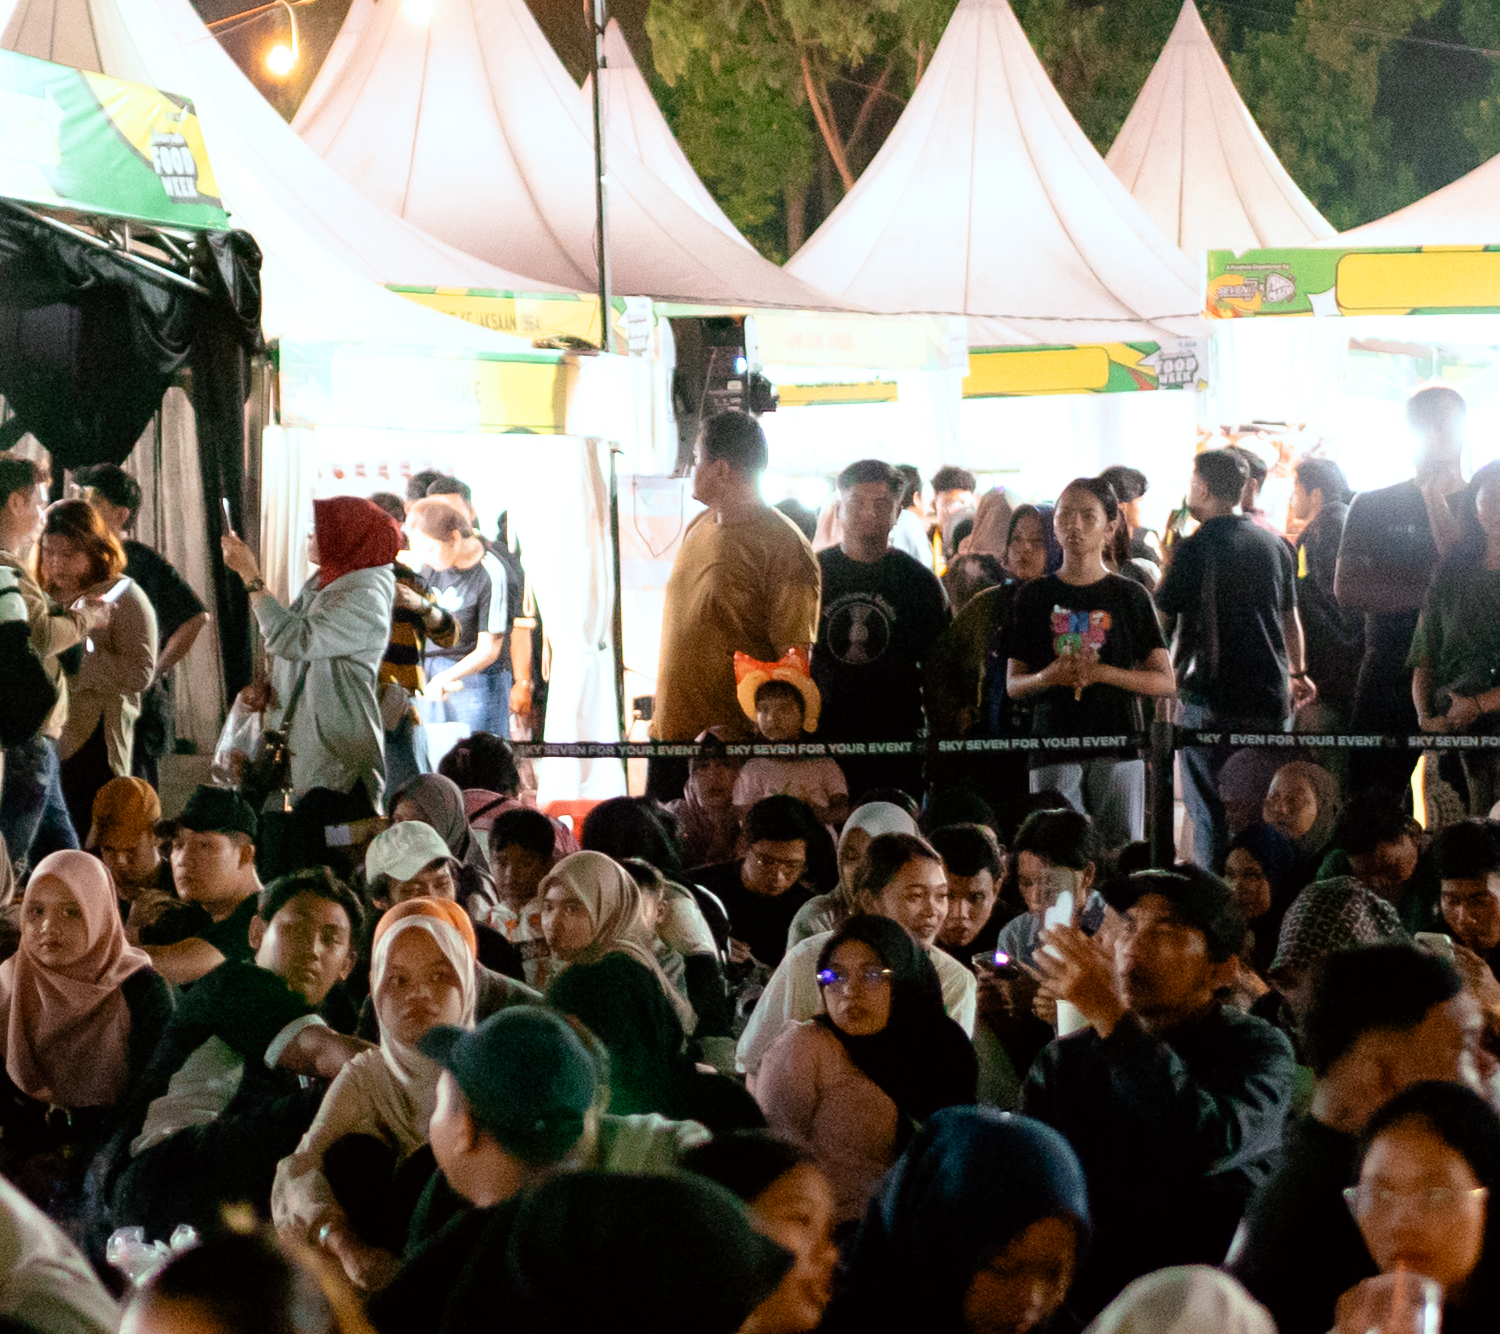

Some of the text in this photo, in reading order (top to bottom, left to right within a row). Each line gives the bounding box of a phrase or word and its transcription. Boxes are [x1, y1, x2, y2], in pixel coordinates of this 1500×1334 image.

[151, 146, 197, 176] FOOD
[161, 175, 199, 197] WEEK
[1155, 357, 1198, 374] FOOD
[938, 736, 1128, 751] SKY SEVEN FOR YOUR EVENT
[1230, 734, 1265, 745] EVEN
[1267, 735, 1295, 746] FOR
[1297, 735, 1335, 746] YOUR
[1338, 736, 1381, 746] EVENT
[1408, 736, 1435, 747] SKY
[1436, 736, 1478, 747] SEVEN
[543, 746, 587, 756] SEVEN
[588, 746, 616, 756] FOR
[618, 745, 657, 756] YOUR
[658, 745, 701, 756] EVENT
[726, 742, 913, 755] SKY SEVEN FOR YOUR EVENT
